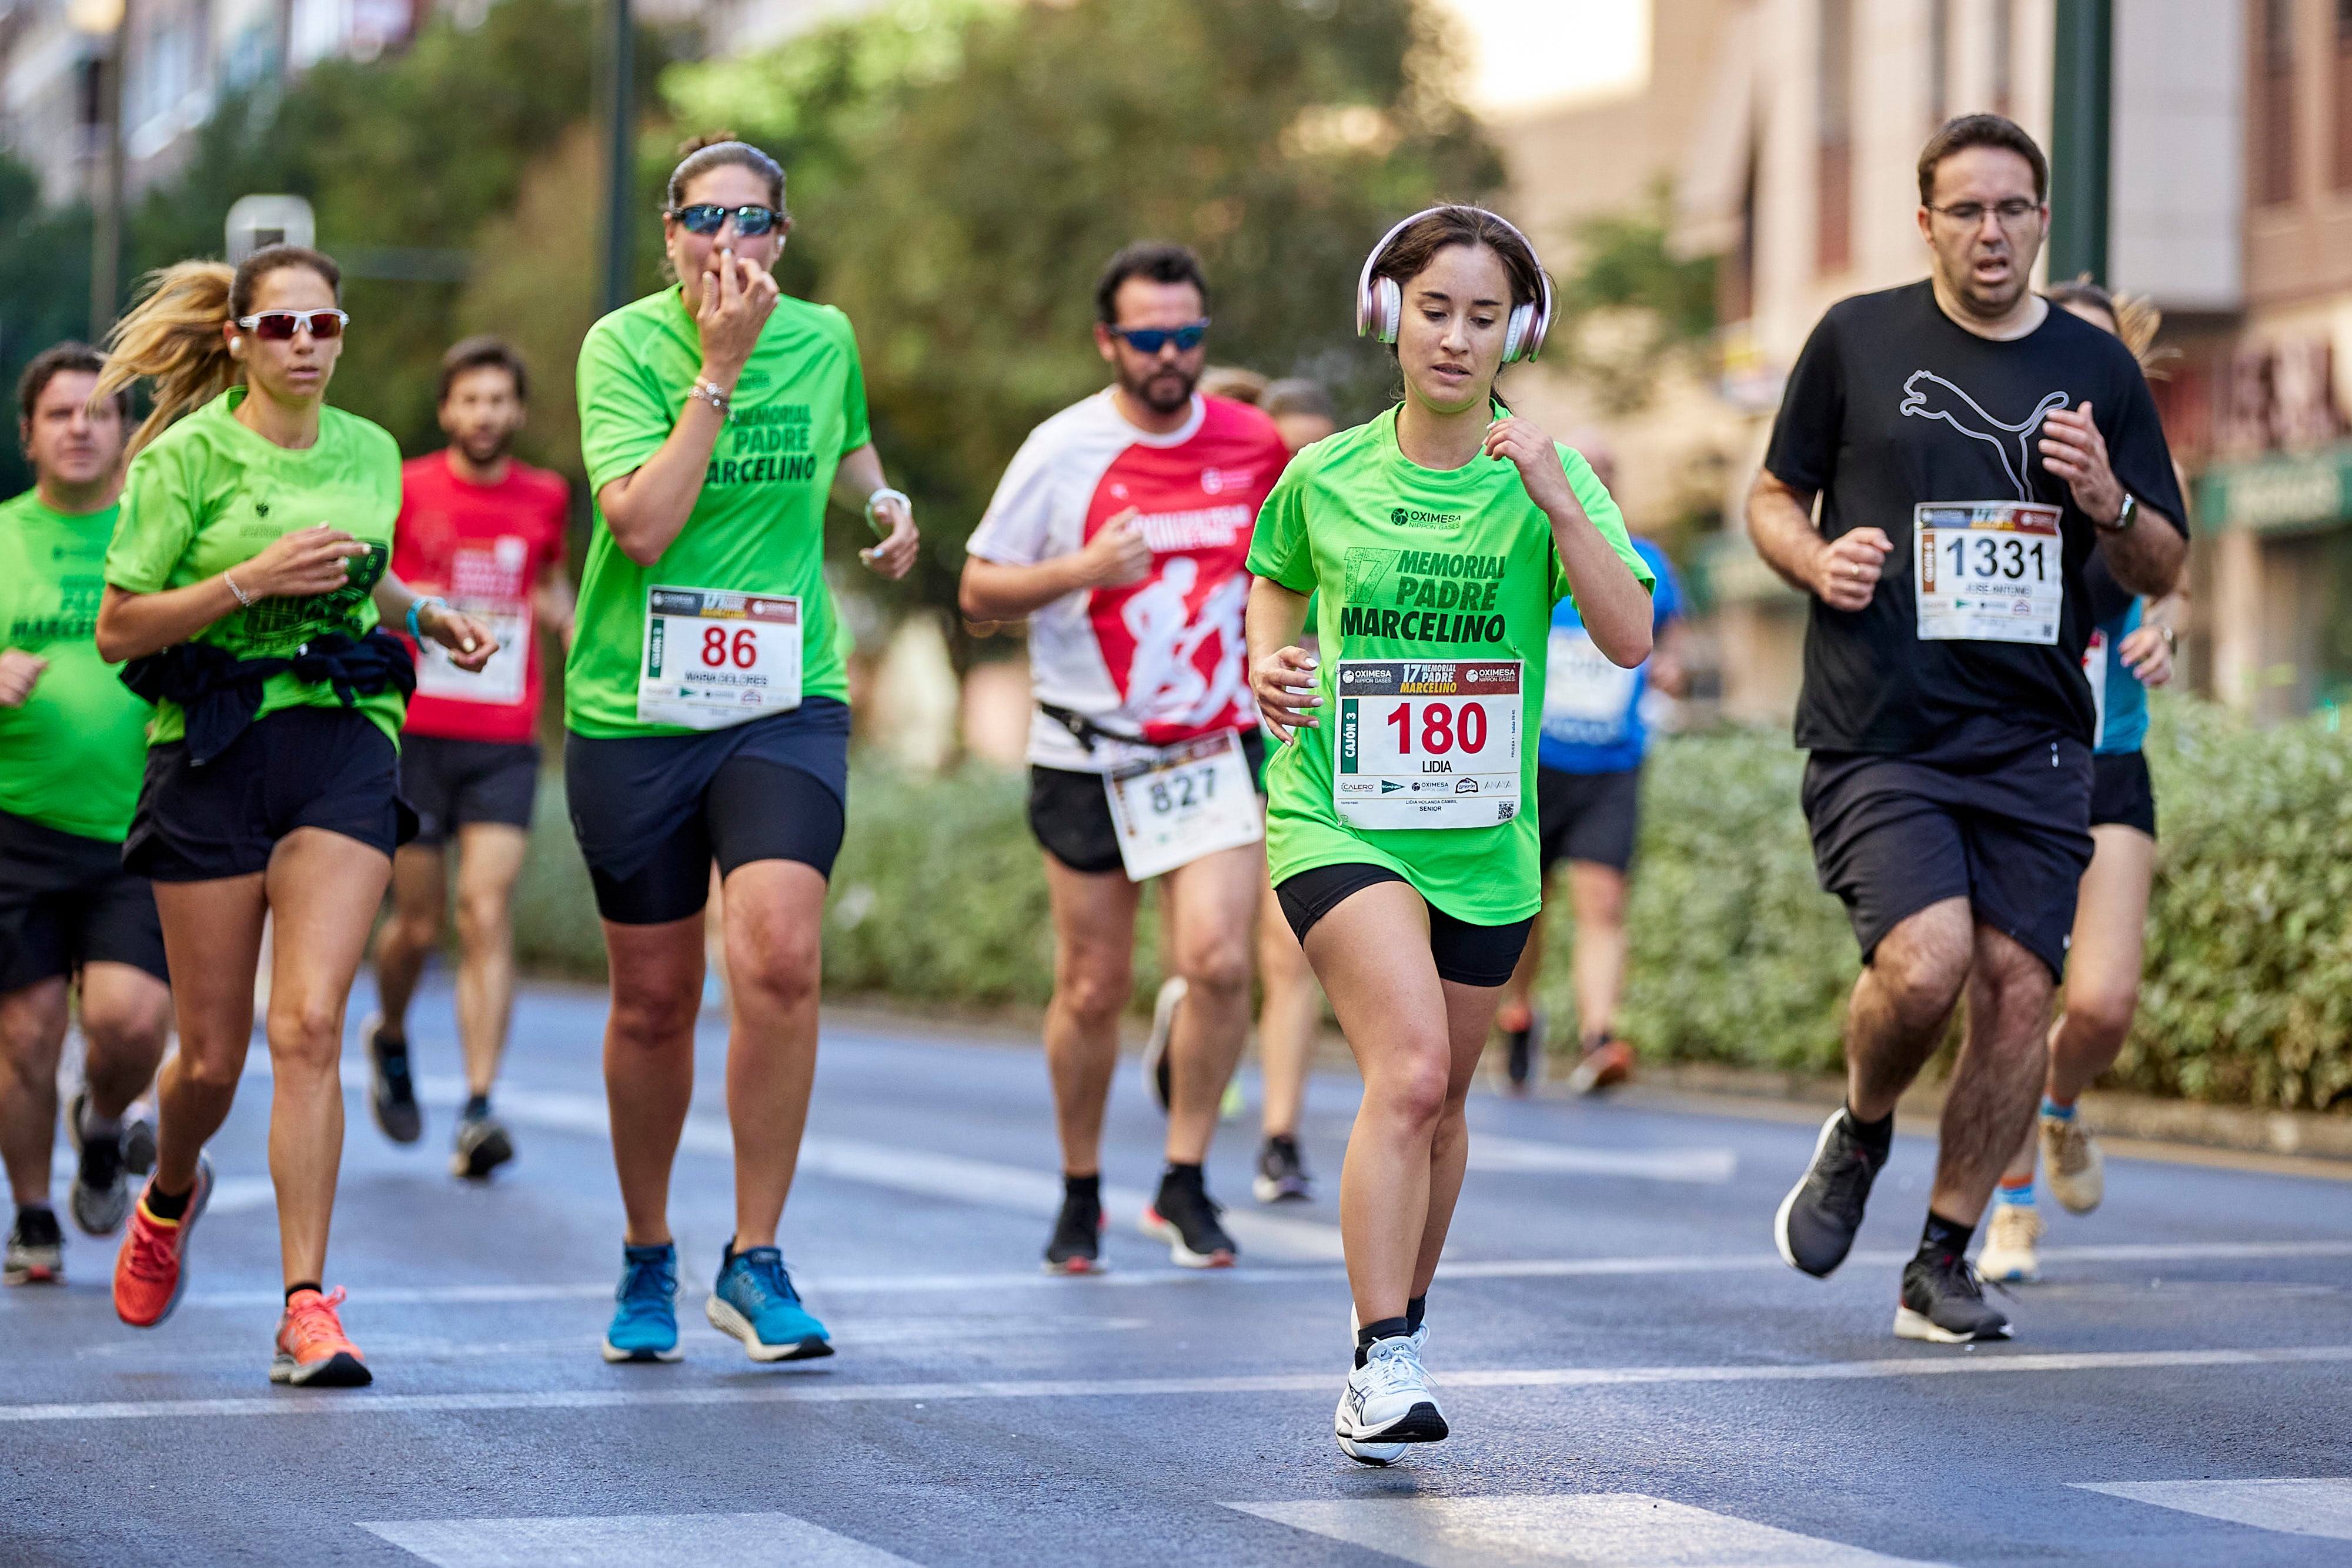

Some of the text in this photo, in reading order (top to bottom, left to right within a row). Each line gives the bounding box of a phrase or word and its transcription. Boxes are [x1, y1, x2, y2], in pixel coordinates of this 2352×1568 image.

[733, 426, 810, 454] PADRE
[706, 454, 818, 484] ARCELINO
[1411, 511, 1461, 523] OXIMESA
[1947, 537, 2044, 581] 1331
[1344, 547, 1505, 604] 17 MEMORIAL
[1396, 576, 1499, 611] PADRE
[1341, 607, 1505, 643] MARCELINO
[701, 626, 757, 668] 86
[1400, 682, 1457, 693] MARCELINO
[1403, 664, 1456, 683] 17 MEMORIAL
[1421, 672, 1454, 683] PADRE
[1343, 723, 1356, 758] CAJÓN
[1388, 702, 1487, 754] 180
[1422, 760, 1452, 773] LIDIA
[1150, 767, 1215, 814] 827
[1484, 780, 1512, 789] ANAYA
